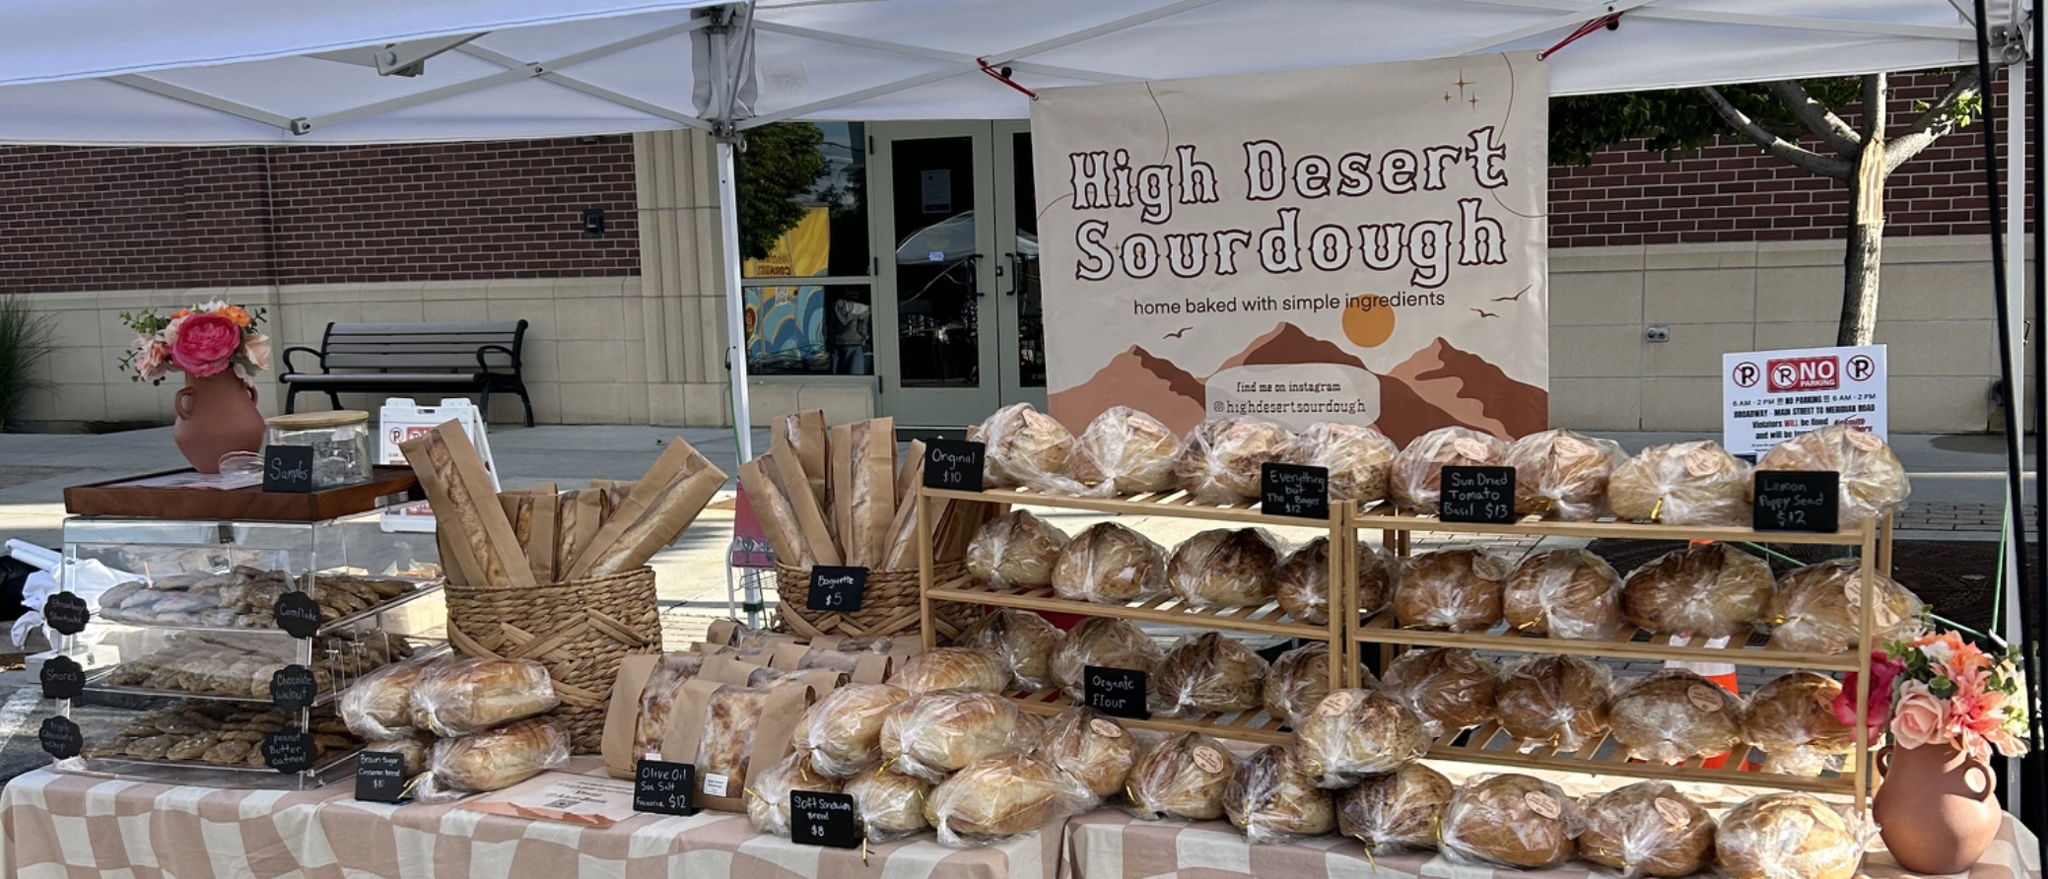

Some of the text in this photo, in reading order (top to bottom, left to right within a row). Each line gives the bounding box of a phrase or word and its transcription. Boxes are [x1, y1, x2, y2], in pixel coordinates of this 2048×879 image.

[1069, 126, 1508, 224] High Desert
[1075, 198, 1507, 289] Sourdough
[1134, 291, 1446, 314] home baked with simple ingredients
[1801, 361, 1835, 379] NO
[1236, 381, 1341, 393] find me on instagram
[1801, 379, 1835, 387] PARKING
[1785, 397, 1794, 405] NO
[1795, 396, 1822, 404] PARKING
[1734, 409, 1768, 418] BROADWAY
[1774, 408, 1791, 416] MAIN
[1792, 407, 1814, 415] STREET
[1816, 406, 1823, 414] TO
[1826, 405, 1856, 413] MERIDIAN
[1858, 403, 1875, 412] ROAD
[1752, 420, 1782, 428] Violators
[1784, 419, 1798, 427] WILL
[270, 457, 309, 483] Samples
[943, 469, 962, 483] $10
[1269, 469, 1326, 492] Everything
[1451, 472, 1509, 487] Sun Dried
[1763, 480, 1807, 492] Lemon
[1266, 493, 1319, 508] The Bagel
[1448, 487, 1500, 501] Tomato
[1284, 502, 1302, 514] $12
[1758, 494, 1791, 510] Poppy
[1443, 502, 1509, 519] Basil $13
[1776, 509, 1808, 527] $12
[1092, 674, 1136, 691] Organic
[1092, 693, 1127, 709] Flour
[641, 767, 687, 780] Olive Oil
[641, 781, 655, 791] Sea
[668, 793, 686, 808] $12
[793, 795, 817, 810] Soft
[810, 824, 825, 837] $8
